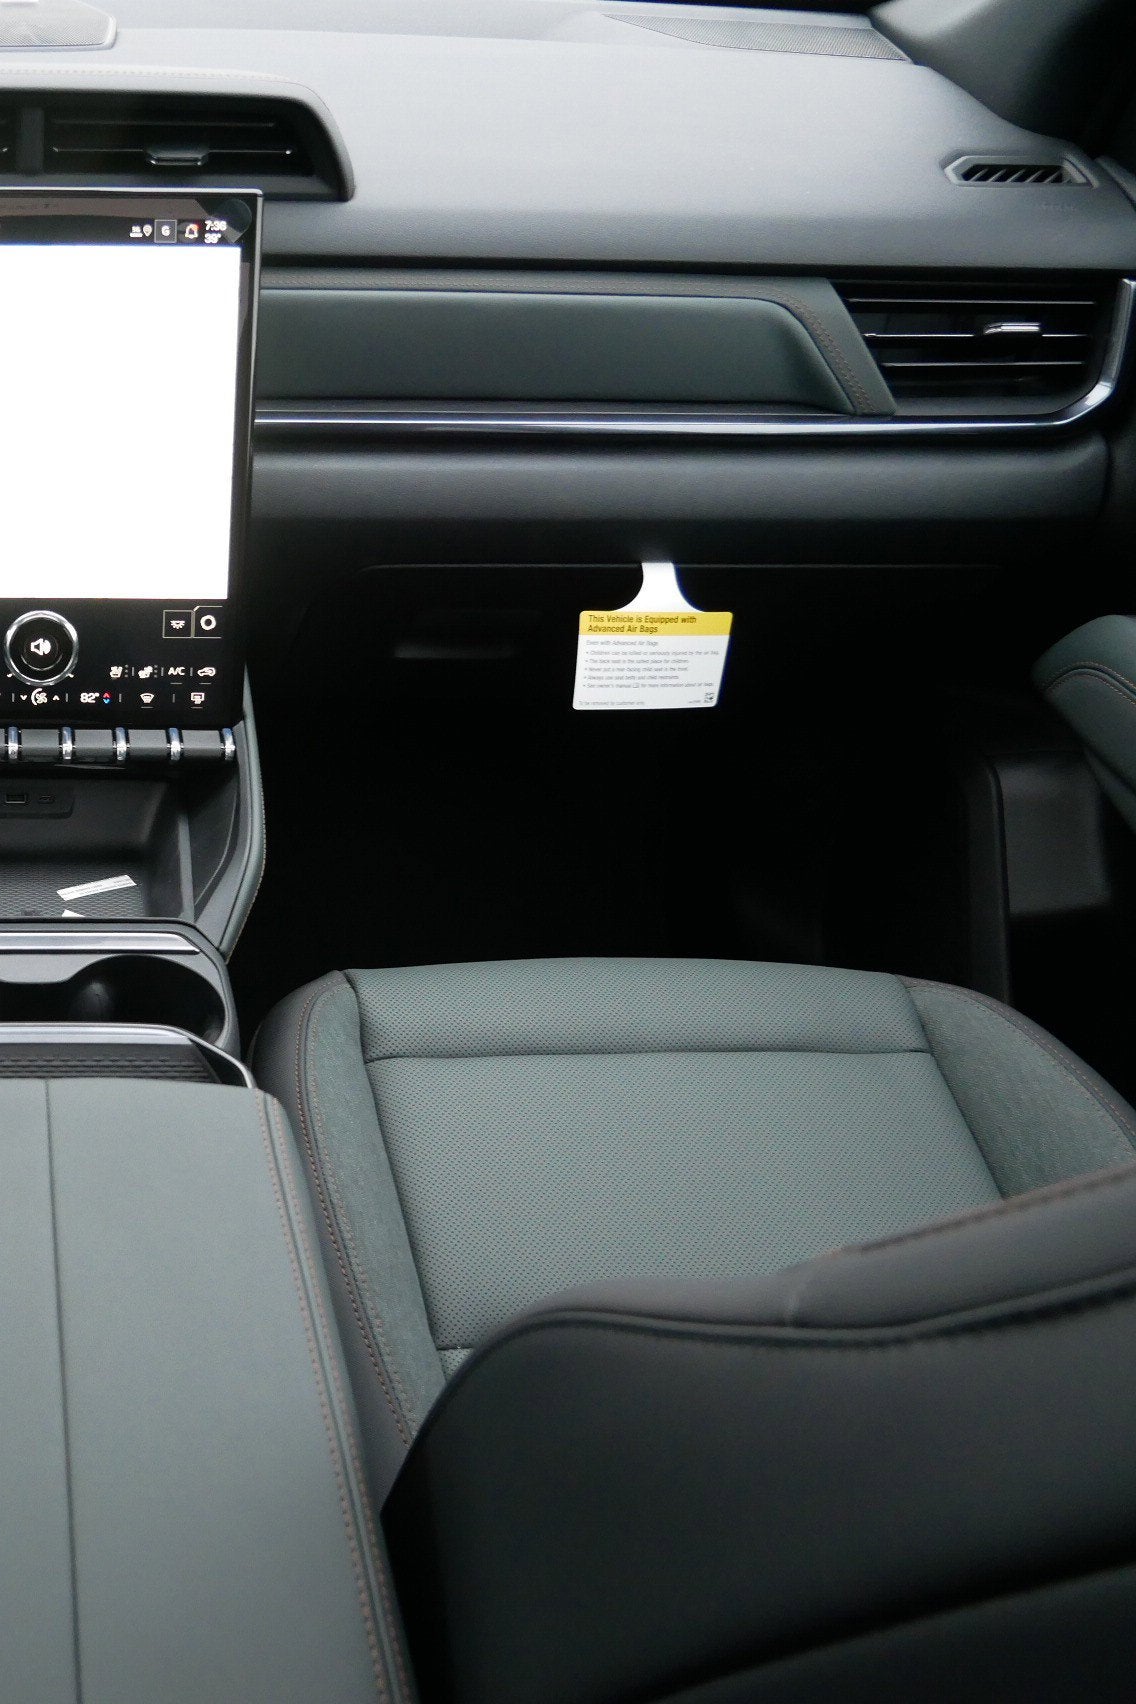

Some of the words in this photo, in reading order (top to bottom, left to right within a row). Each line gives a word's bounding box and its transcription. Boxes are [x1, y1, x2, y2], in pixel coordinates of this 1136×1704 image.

[204, 220, 228, 231] 7:36
[589, 615, 605, 623] This
[606, 615, 634, 623] Vehicle
[635, 615, 643, 623] is
[644, 616, 679, 625] Equipped
[681, 616, 697, 624] with
[639, 626, 659, 634] Bags
[167, 666, 186, 676] A/C
[79, 691, 100, 703] 82°
